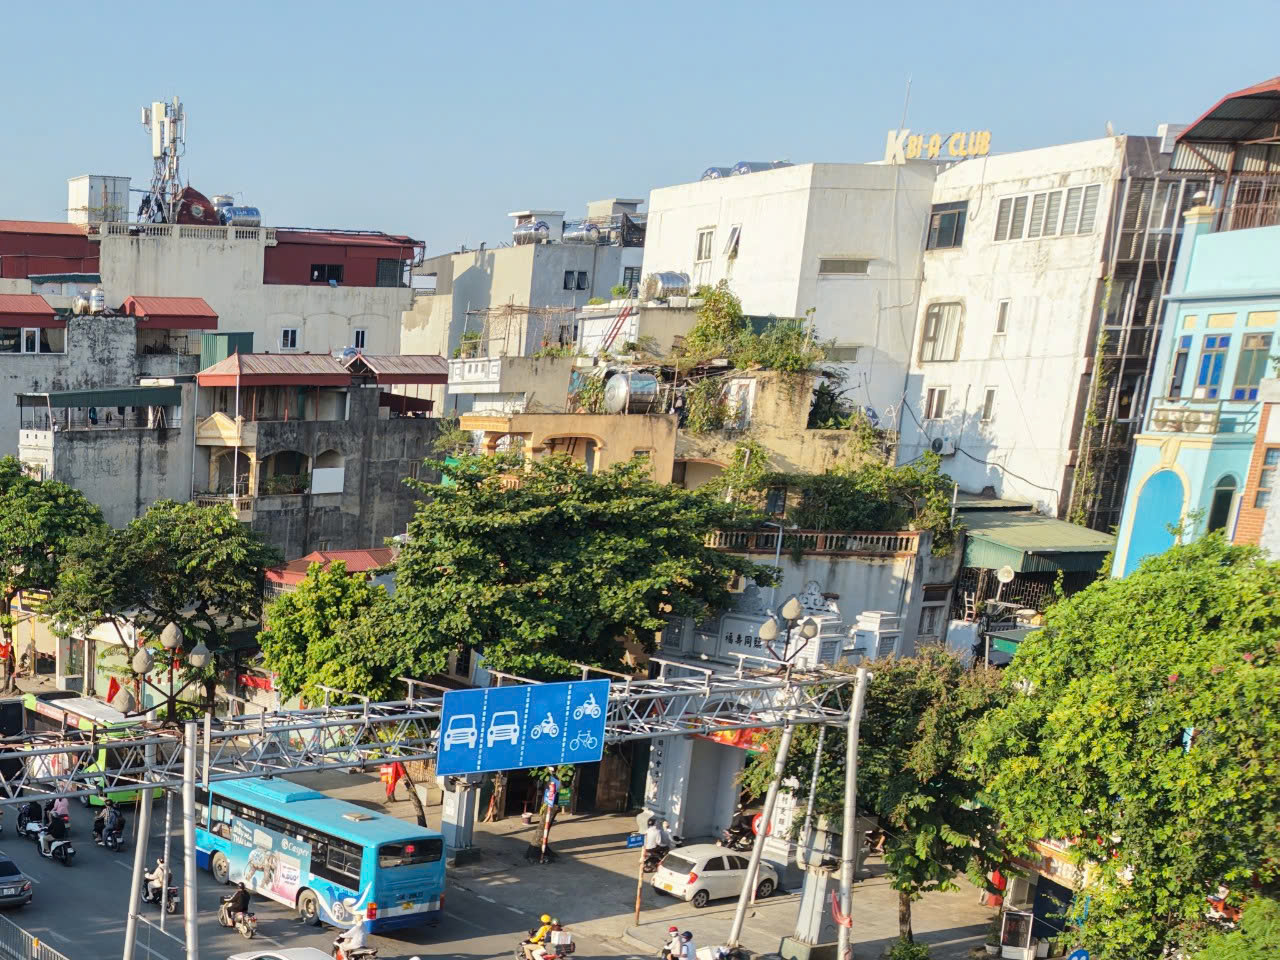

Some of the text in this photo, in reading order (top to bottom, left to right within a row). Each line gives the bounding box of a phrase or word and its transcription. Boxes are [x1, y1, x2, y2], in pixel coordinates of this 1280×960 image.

[906, 133, 941, 159] BI-A
[949, 130, 992, 156] CLUB
[288, 842, 309, 857] Casper
